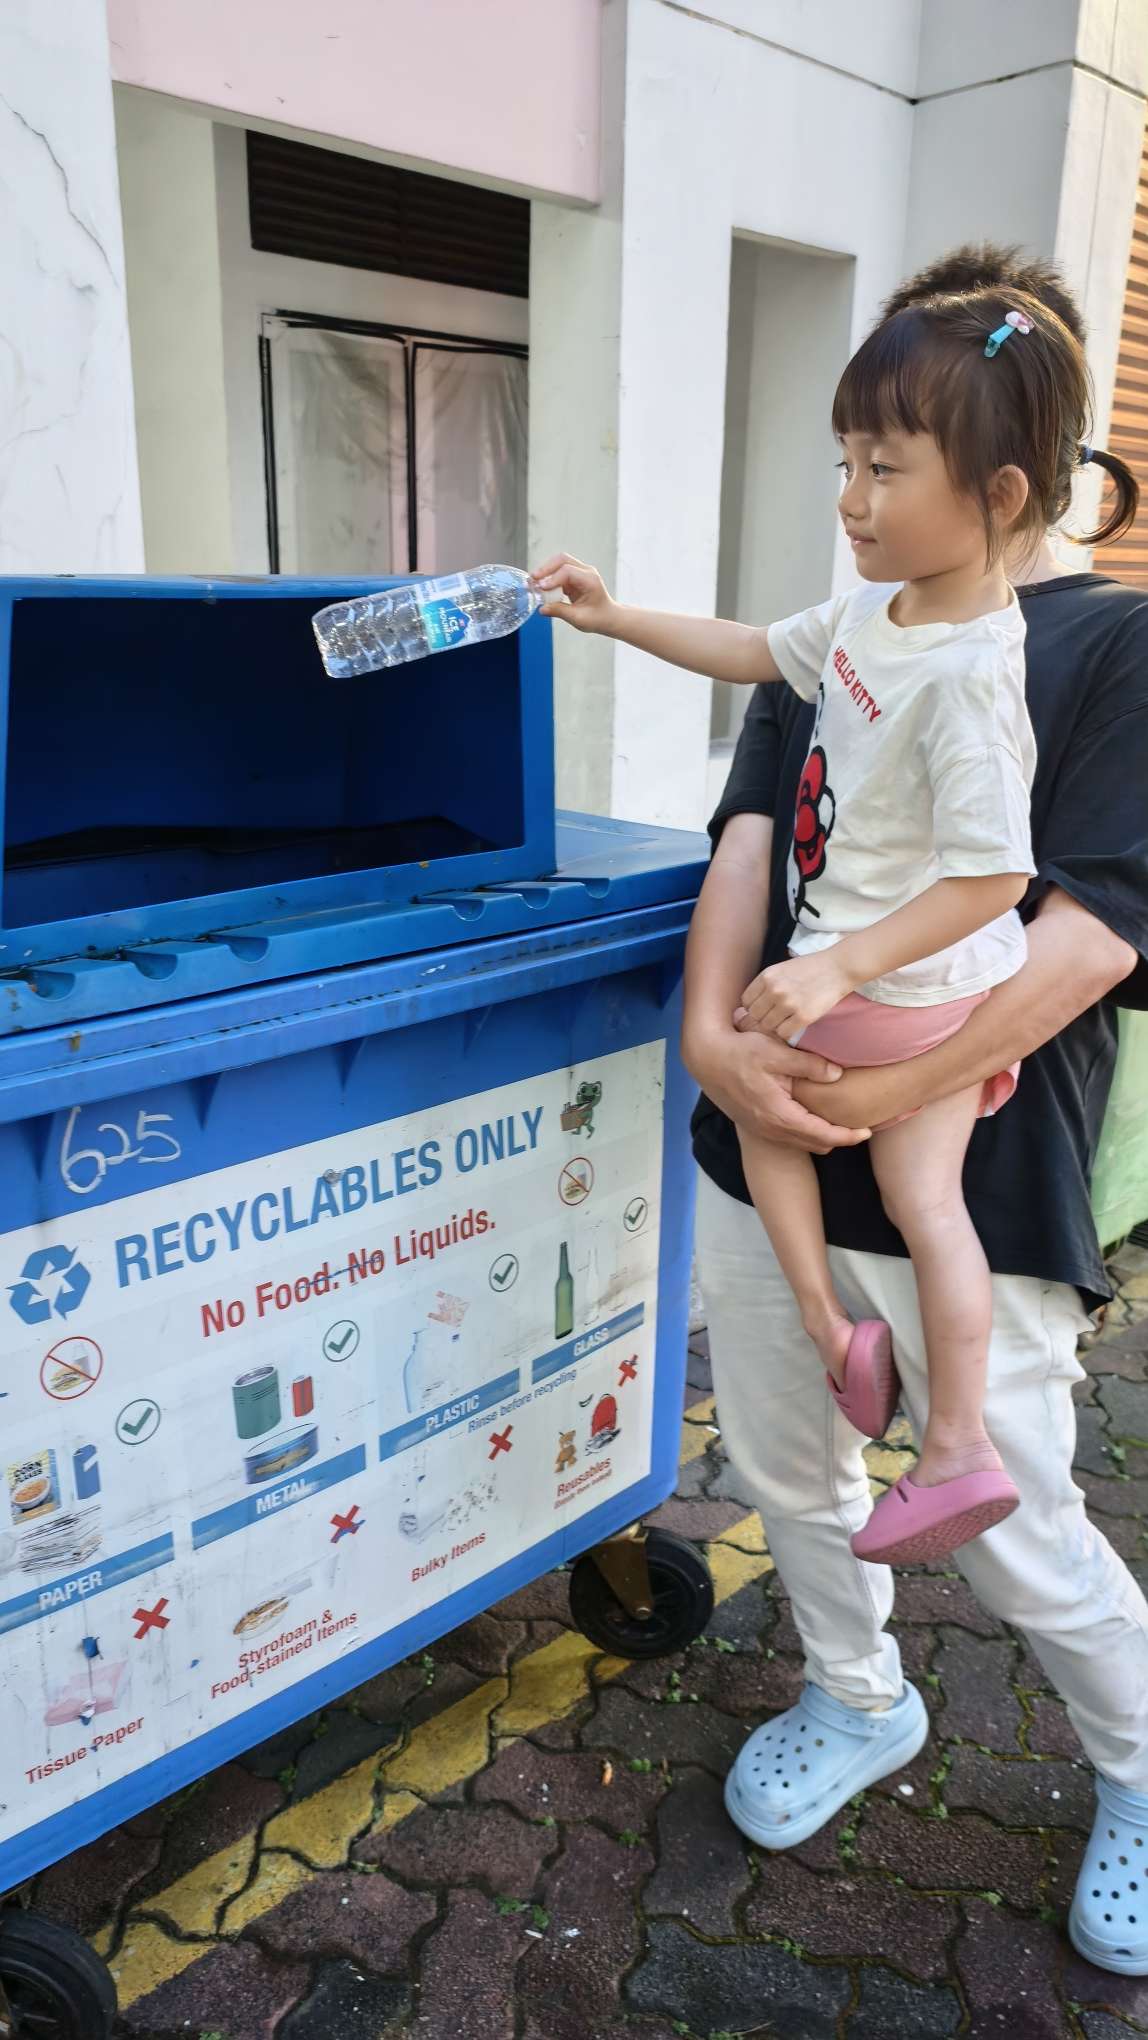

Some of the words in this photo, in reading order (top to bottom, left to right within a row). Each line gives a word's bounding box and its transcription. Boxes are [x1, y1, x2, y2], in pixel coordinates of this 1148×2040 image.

[447, 616, 459, 631] ICE
[833, 645, 856, 686] HELLO
[849, 678, 882, 722] KITTY
[60, 1106, 181, 1194] 625
[115, 1141, 442, 1288] RECYCLABLES
[455, 1106, 544, 1173] ONLY
[201, 1299, 245, 1337] No
[255, 1262, 340, 1318] Food.
[348, 1247, 385, 1284] No
[394, 1208, 496, 1265] Liquids.
[573, 1327, 609, 1356] GLASS
[425, 1394, 480, 1432] PLASTIC
[468, 1411, 498, 1433] Rinse
[500, 1392, 532, 1417] before
[534, 1369, 577, 1399] recycling
[255, 1479, 311, 1515] METAL
[557, 1457, 611, 1497] Reusables
[411, 1554, 448, 1582] Bulky
[451, 1532, 486, 1560] Items
[38, 1570, 103, 1611] PAPER
[211, 1636, 313, 1699] Food-stained
[317, 1612, 358, 1642] Items
[238, 1618, 317, 1668] Styrofoam
[321, 1608, 333, 1624] &
[25, 1747, 87, 1784] Tissue
[92, 1716, 145, 1749] Paper
